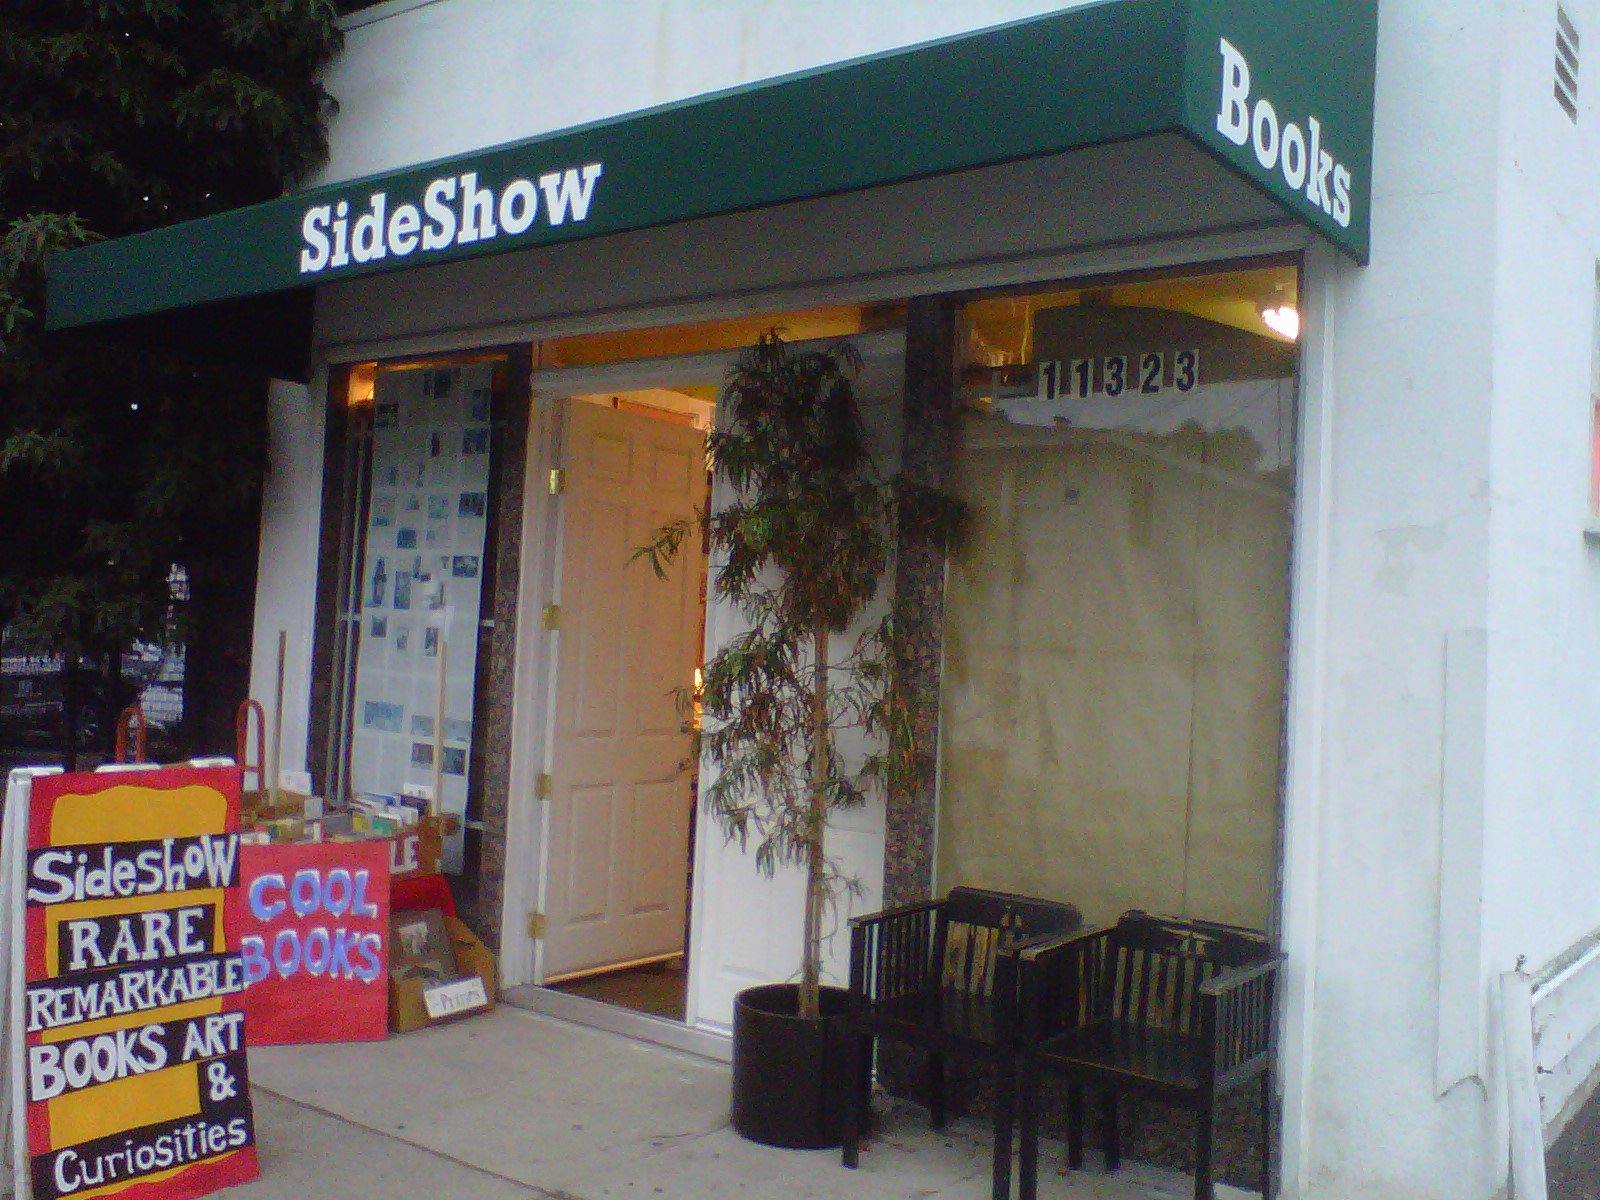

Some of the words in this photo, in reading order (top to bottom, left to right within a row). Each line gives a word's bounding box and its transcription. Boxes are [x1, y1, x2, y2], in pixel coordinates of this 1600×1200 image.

[1216, 37, 1351, 229] Books
[1041, 350, 1198, 400] 11323
[249, 868, 378, 922] COOL
[68, 907, 205, 970] RARE
[241, 926, 382, 990] BOOKS
[27, 958, 245, 1032] REMARKABLE
[29, 1024, 168, 1102] BOOKS
[181, 1012, 244, 1061] ART
[207, 1061, 237, 1101] &
[54, 1118, 247, 1193] Curiosities
